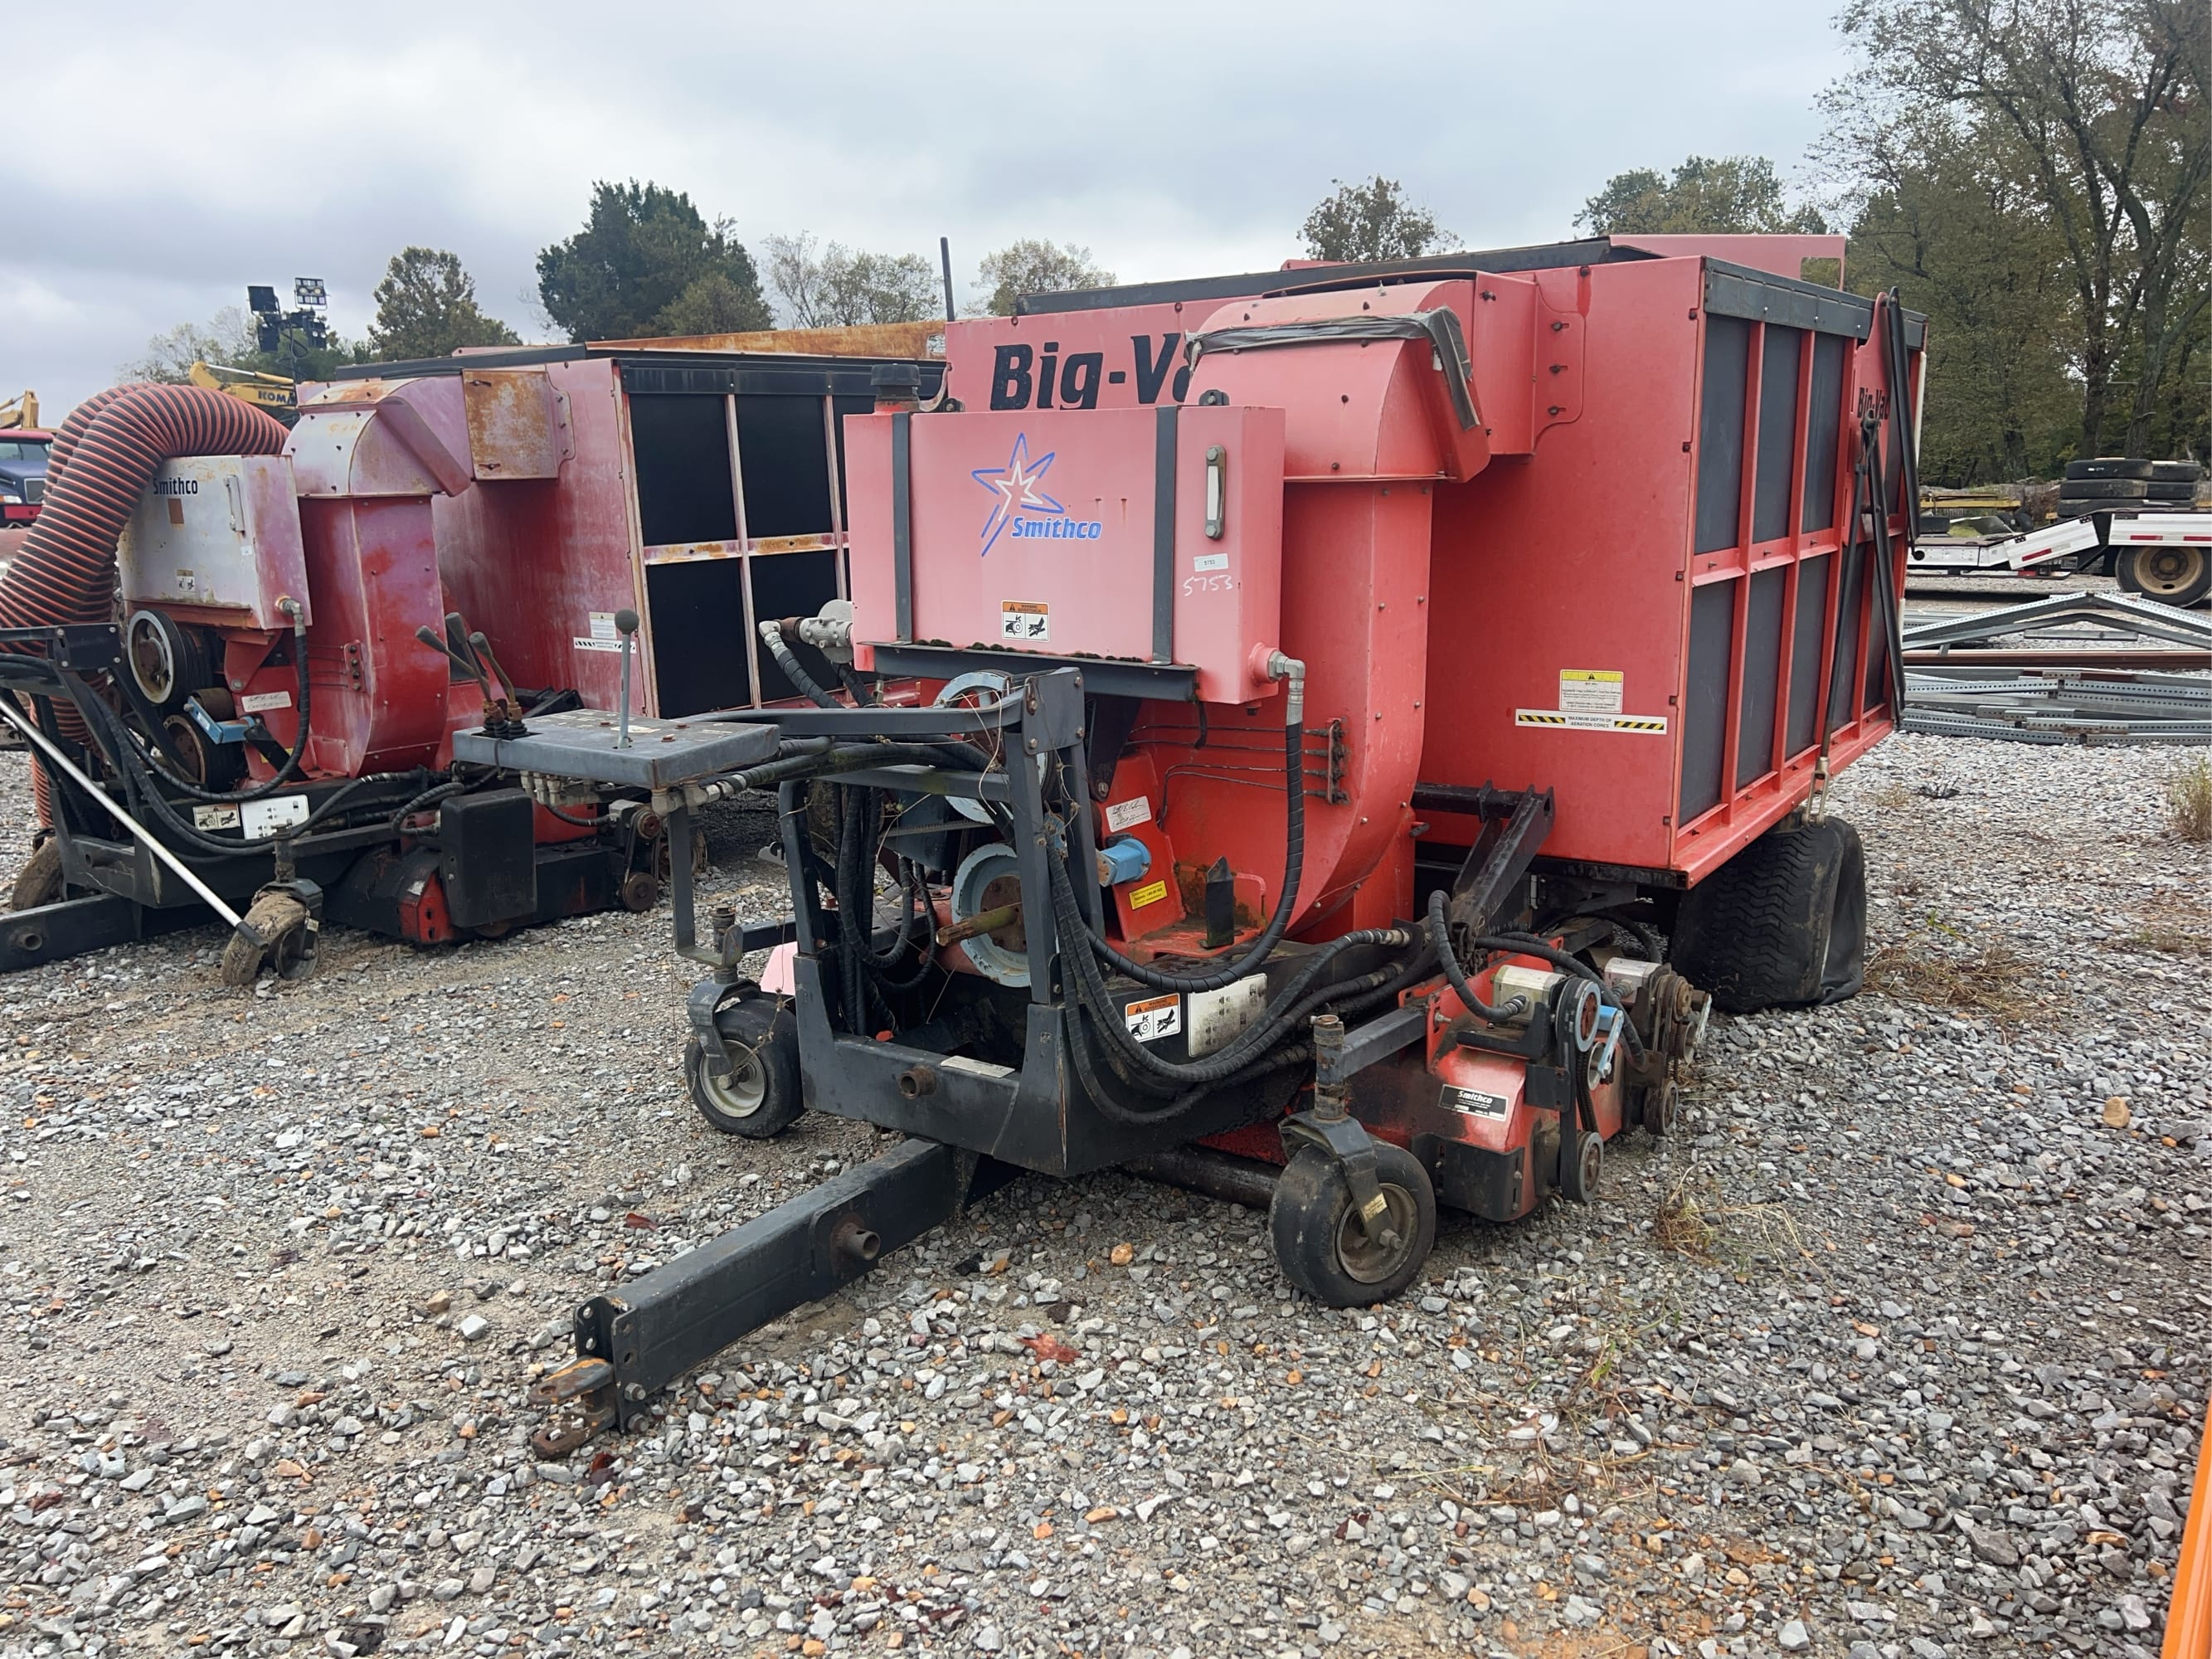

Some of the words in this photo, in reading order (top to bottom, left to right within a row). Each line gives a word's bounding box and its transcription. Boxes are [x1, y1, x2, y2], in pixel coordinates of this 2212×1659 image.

[153, 477, 198, 495] Smithco
[1011, 517, 1102, 539] Smithco
[1183, 575, 1233, 596] 5753
[1457, 1090, 1493, 1104] Smithco
